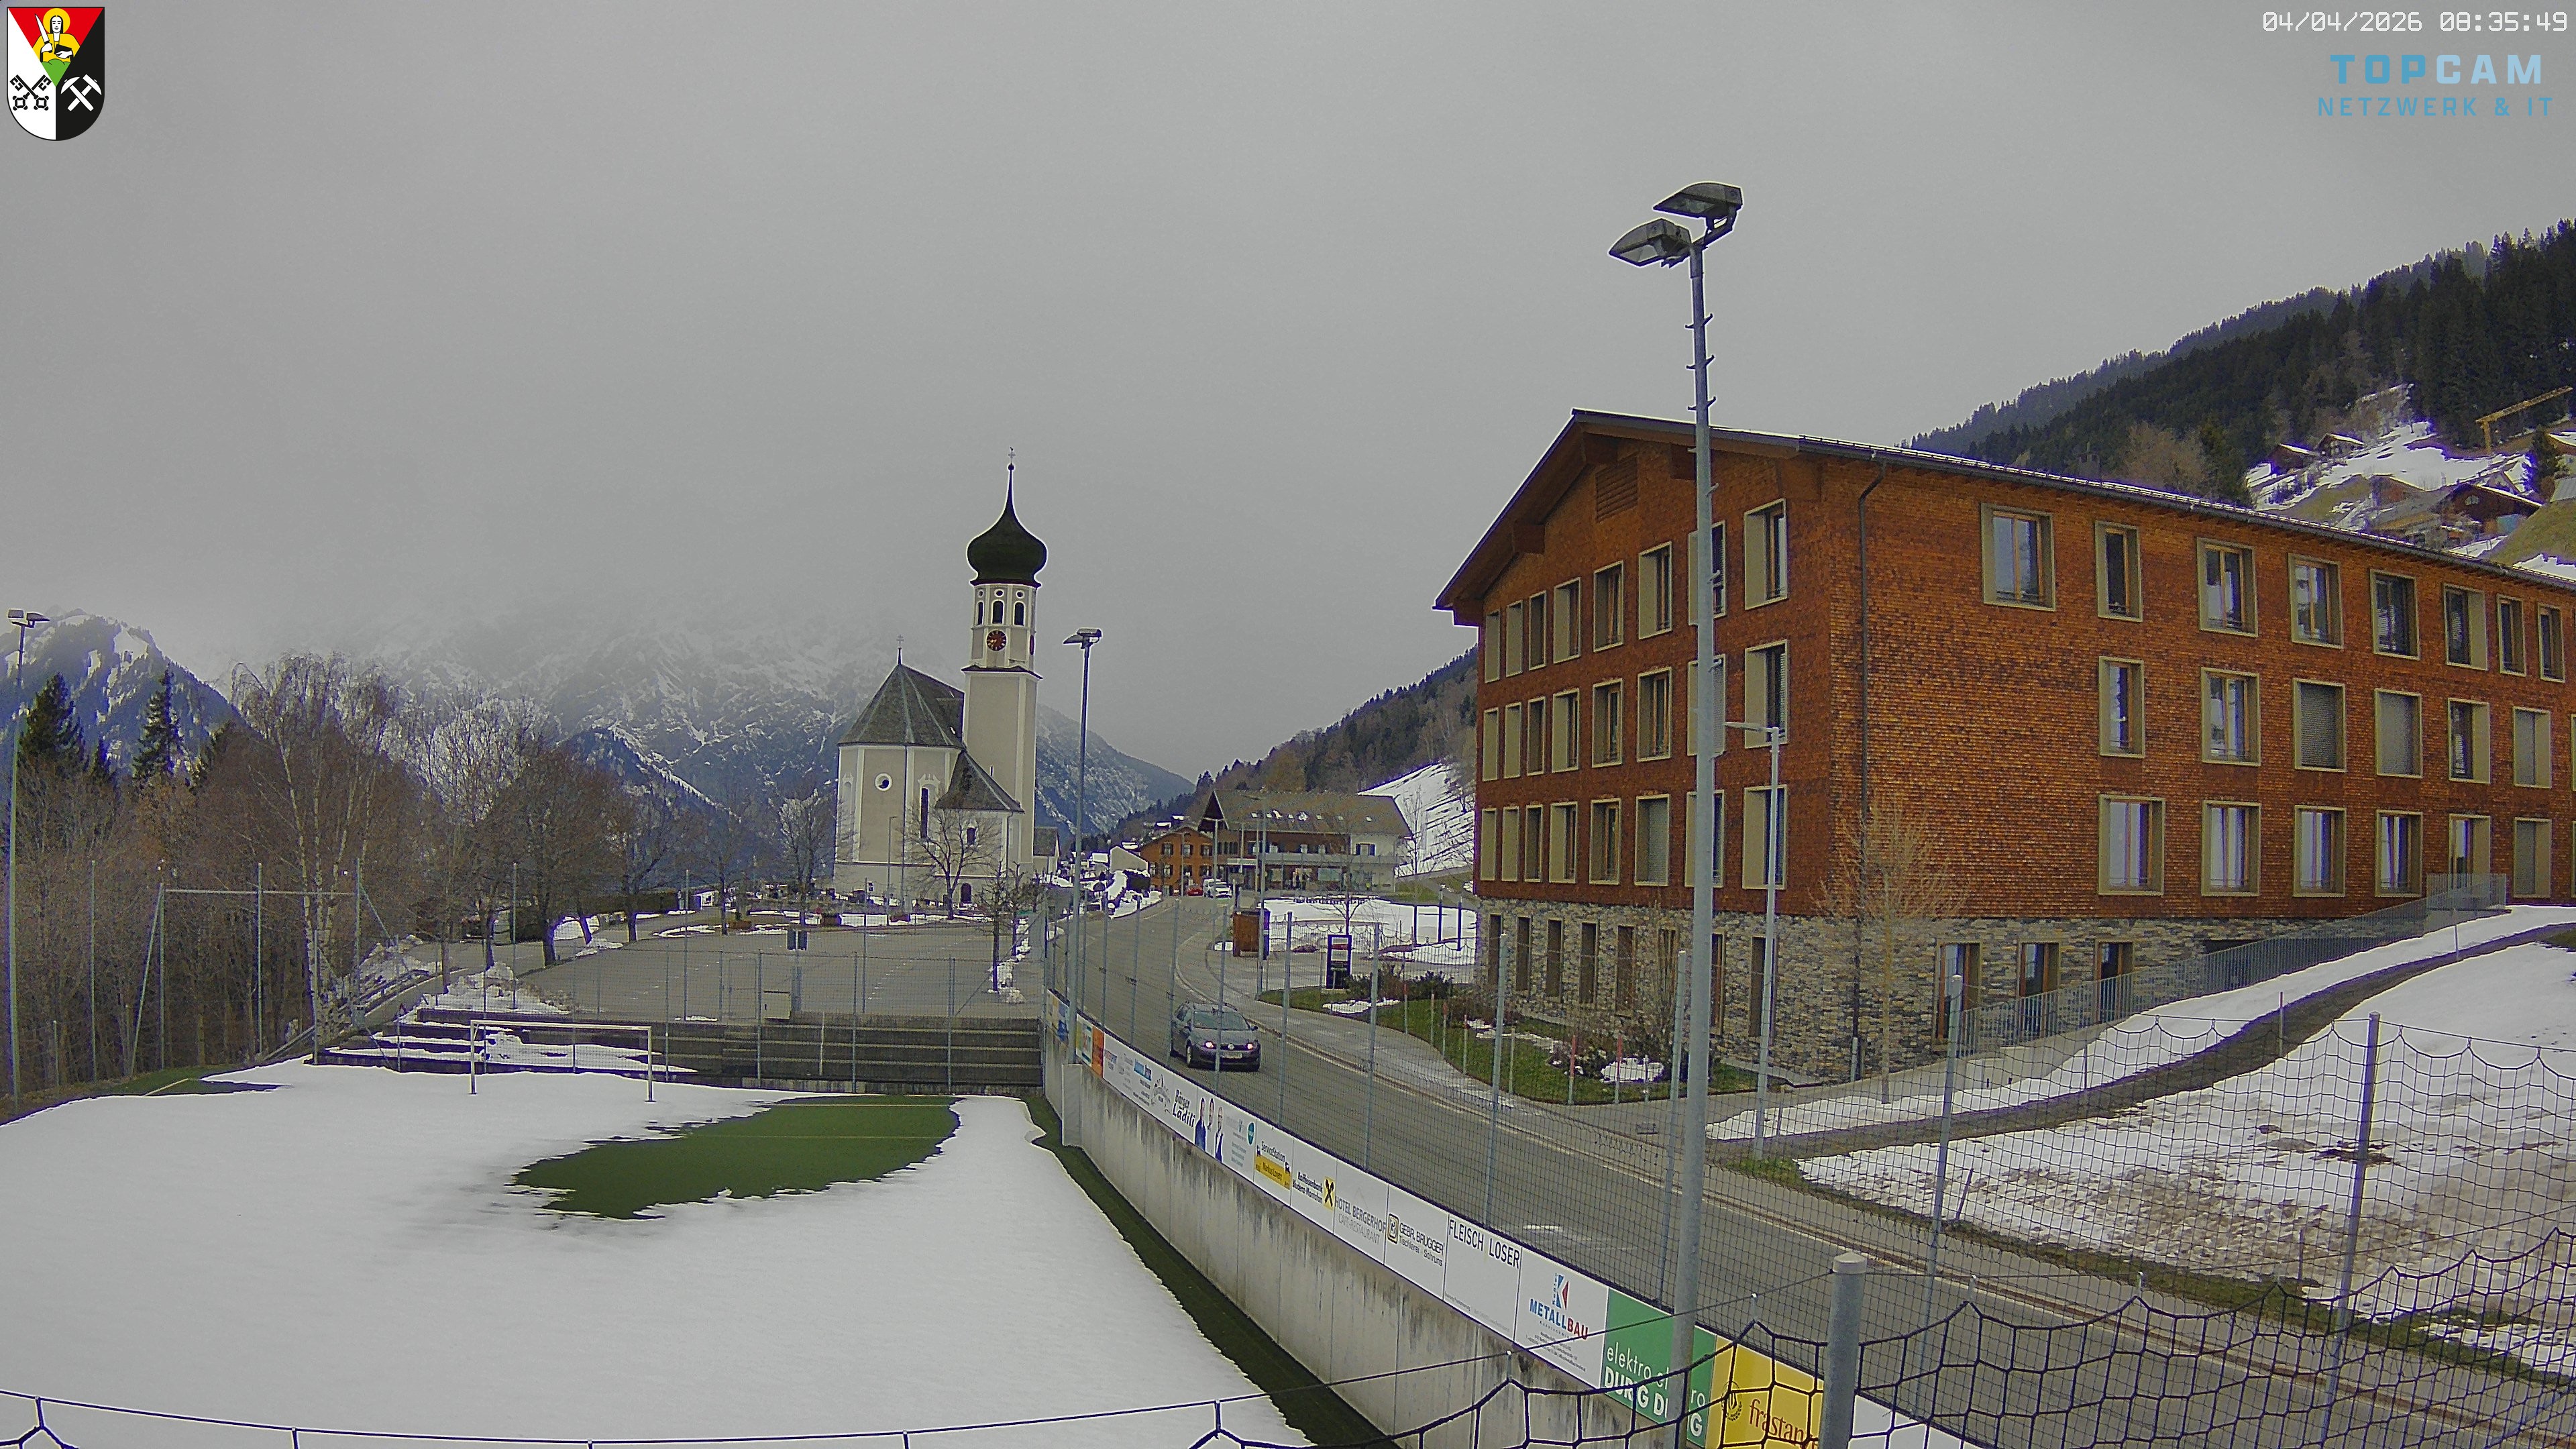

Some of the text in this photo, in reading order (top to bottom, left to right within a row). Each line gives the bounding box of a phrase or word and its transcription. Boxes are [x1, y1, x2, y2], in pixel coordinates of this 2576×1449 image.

[1335, 1195, 1351, 1215] HOTEL
[1449, 1219, 1520, 1269] FLEISCH LOSER
[1529, 1298, 1589, 1340] METALLBAU
[1604, 1366, 1649, 1408] DURG
[1607, 1342, 1652, 1379] elektro
[1656, 1366, 1705, 1407] elro
